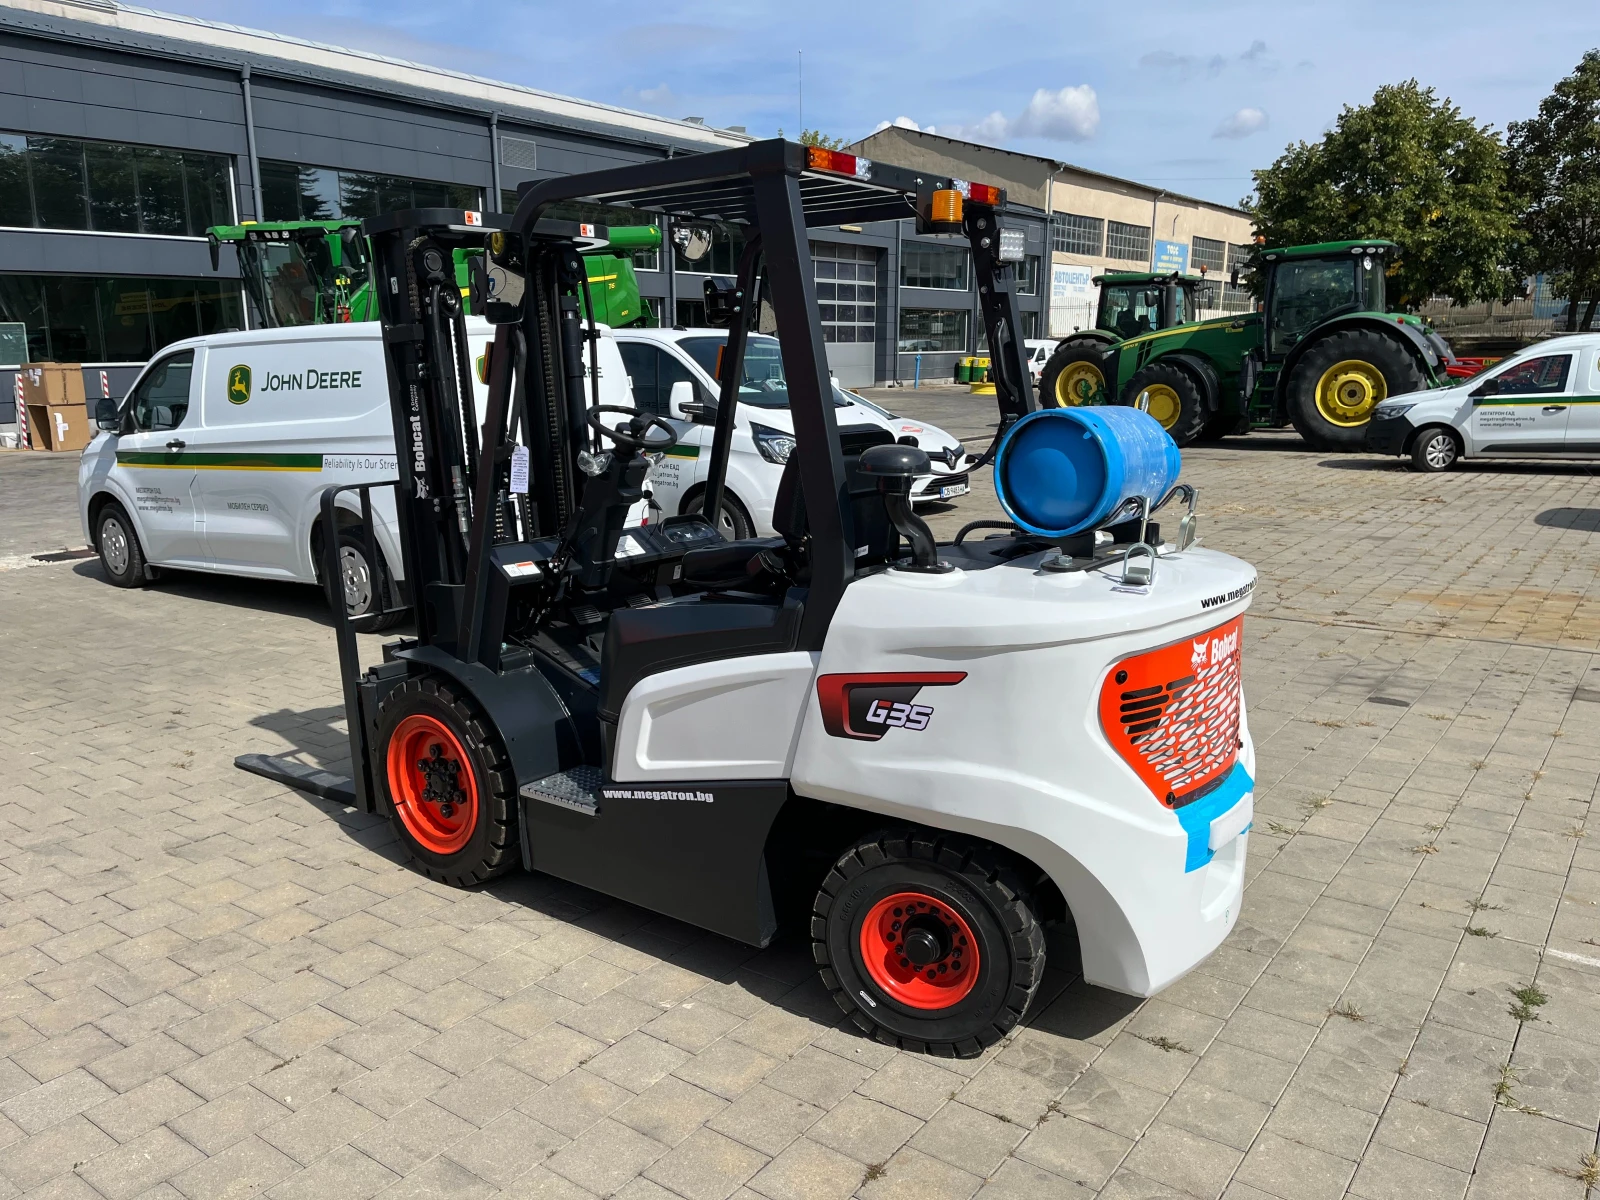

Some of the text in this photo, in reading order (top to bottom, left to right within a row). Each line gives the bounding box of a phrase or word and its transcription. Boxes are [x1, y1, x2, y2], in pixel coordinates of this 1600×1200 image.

[1053, 270, 1090, 285] АВТОЦЕНТЪР
[261, 369, 363, 392] JOHN DEERE
[409, 415, 427, 472] Bobcat
[324, 458, 356, 472] Reliability
[356, 458, 363, 469] Is
[364, 458, 378, 469] Our
[669, 463, 680, 471] ЕАД
[227, 502, 269, 512] МОБИЛЕН СЕРВИЗ
[1211, 625, 1239, 666] Bobcat
[602, 790, 715, 803] www.megatron.bg
